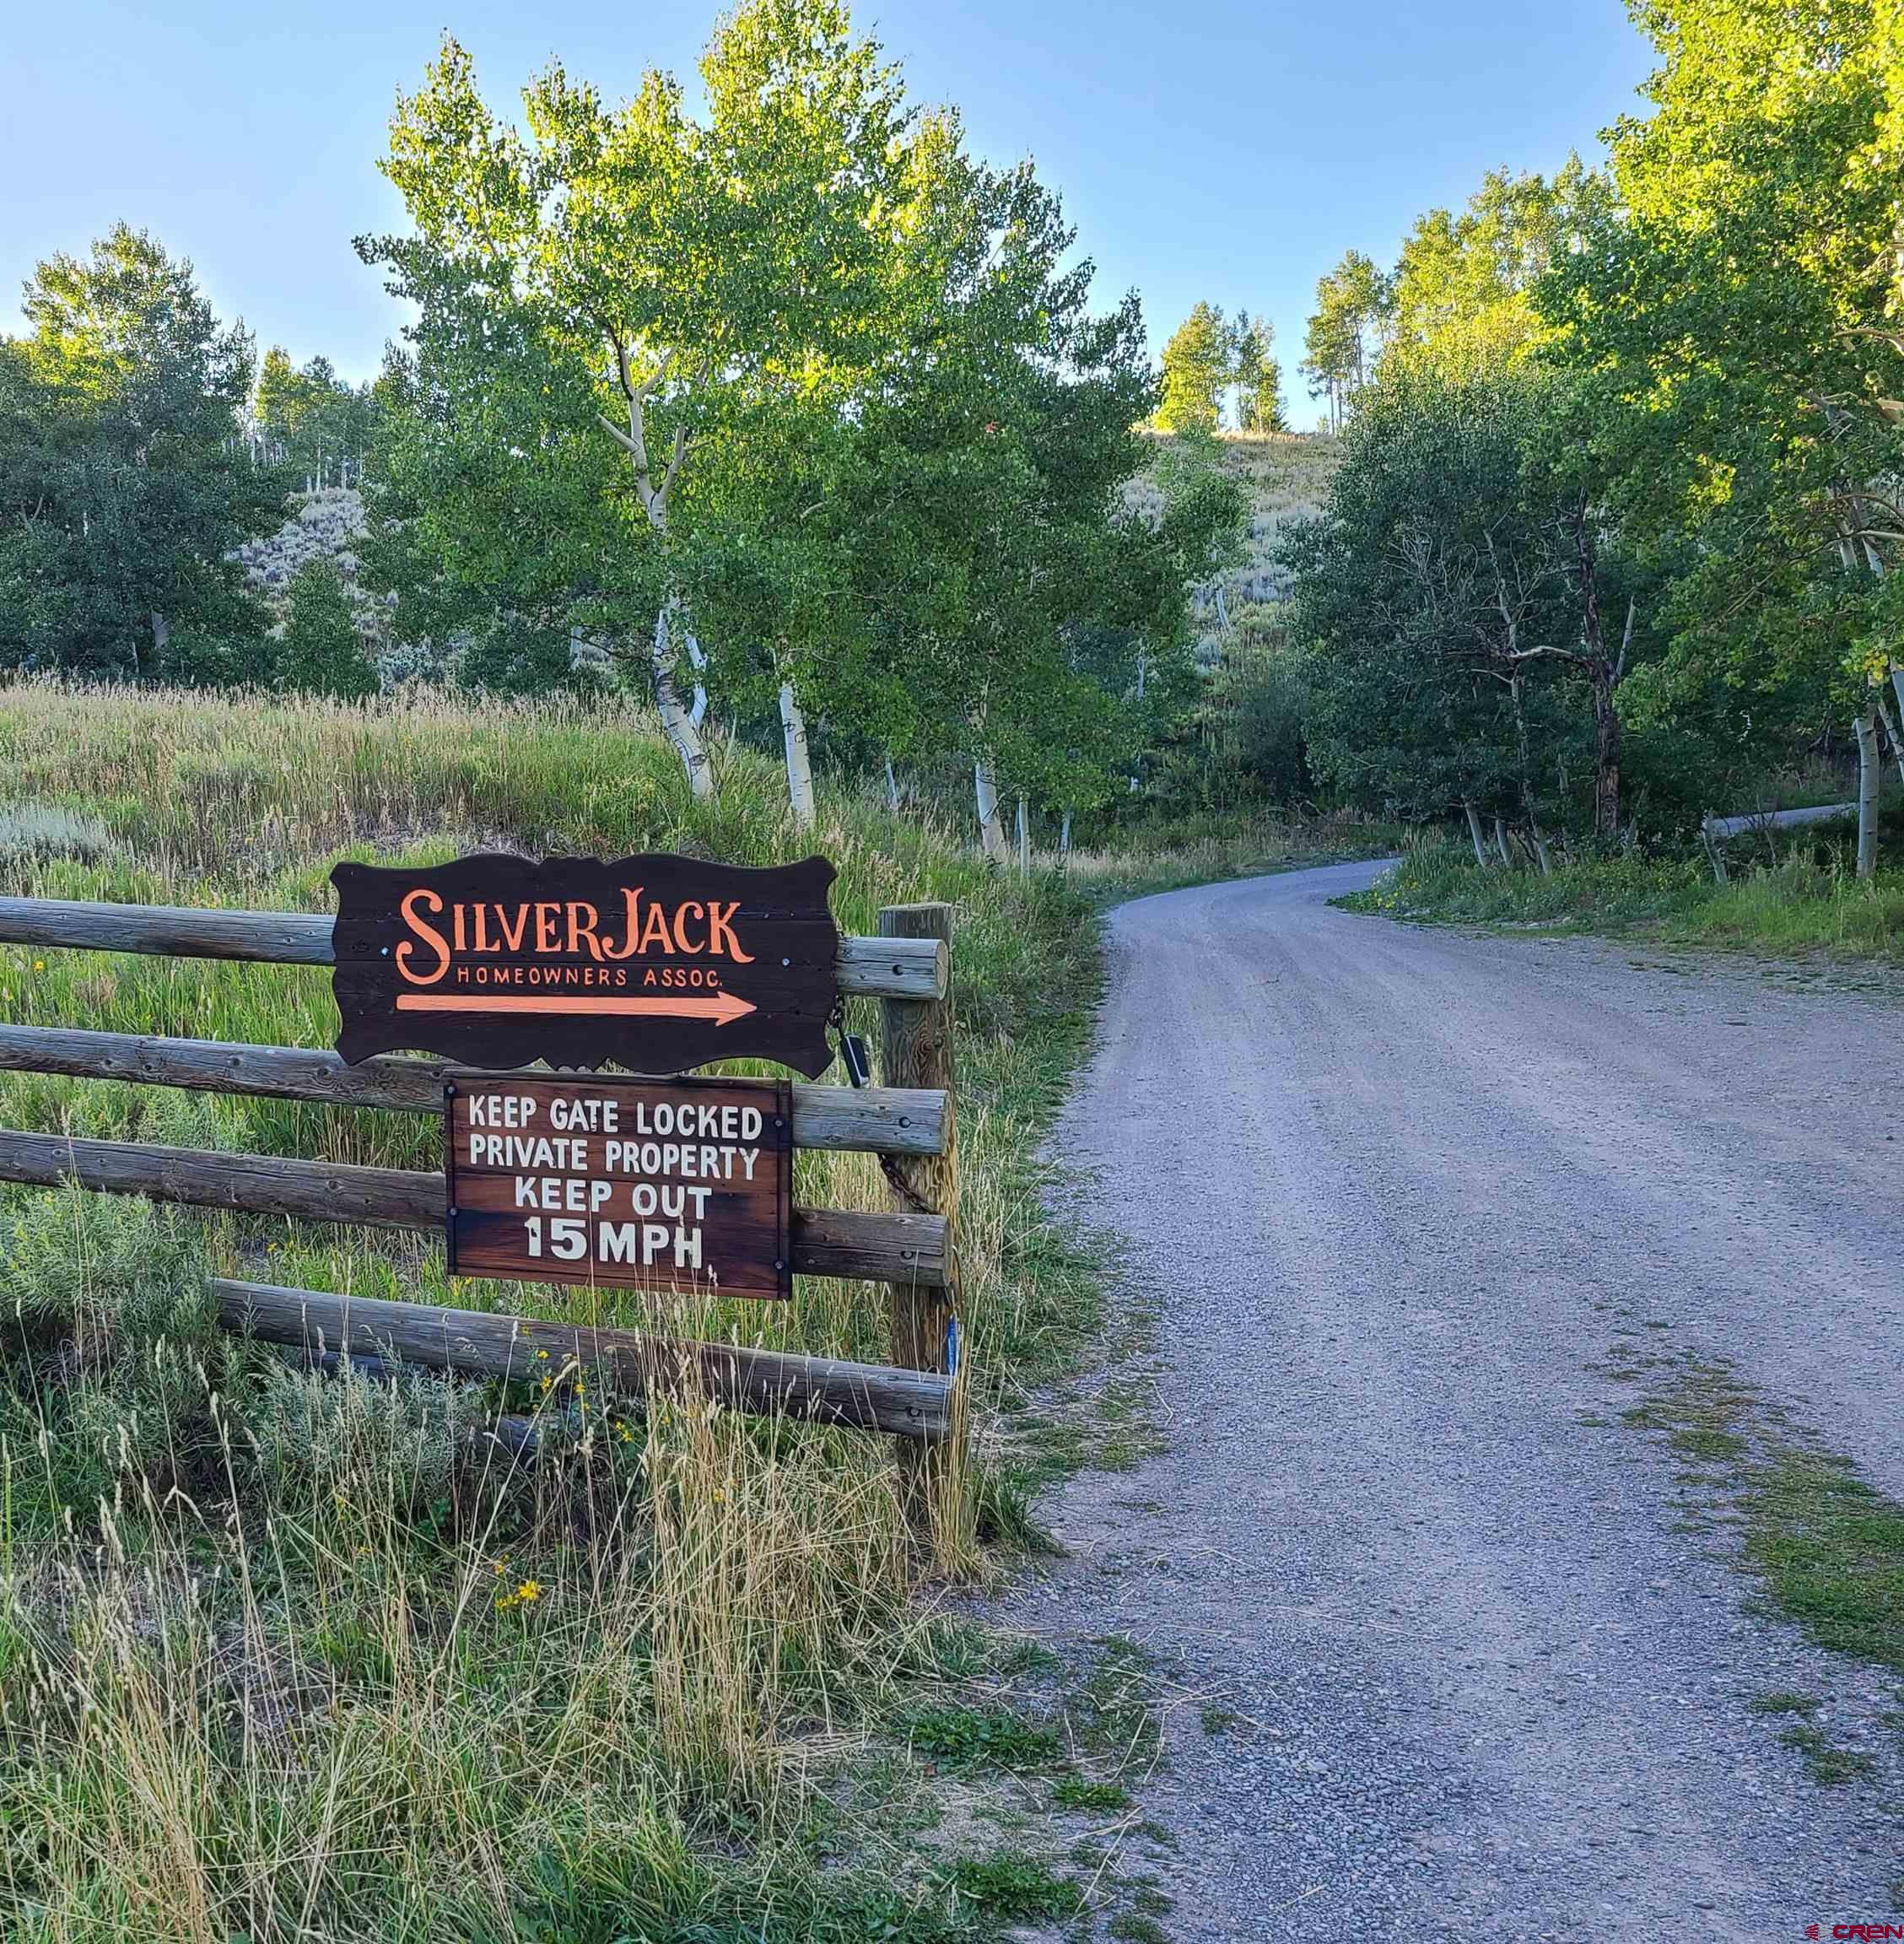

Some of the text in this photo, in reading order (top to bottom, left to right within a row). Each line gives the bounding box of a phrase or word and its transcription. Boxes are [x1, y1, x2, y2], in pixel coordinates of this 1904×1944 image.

[457, 967, 723, 987] HOMEOWNERS ASSOC.
[468, 1094, 763, 1141] KEEP GATE LOCKED
[469, 1133, 761, 1181] PRIVATE PROPERTY
[515, 1176, 713, 1220] KEEP OUT
[598, 1221, 704, 1270] MPH
